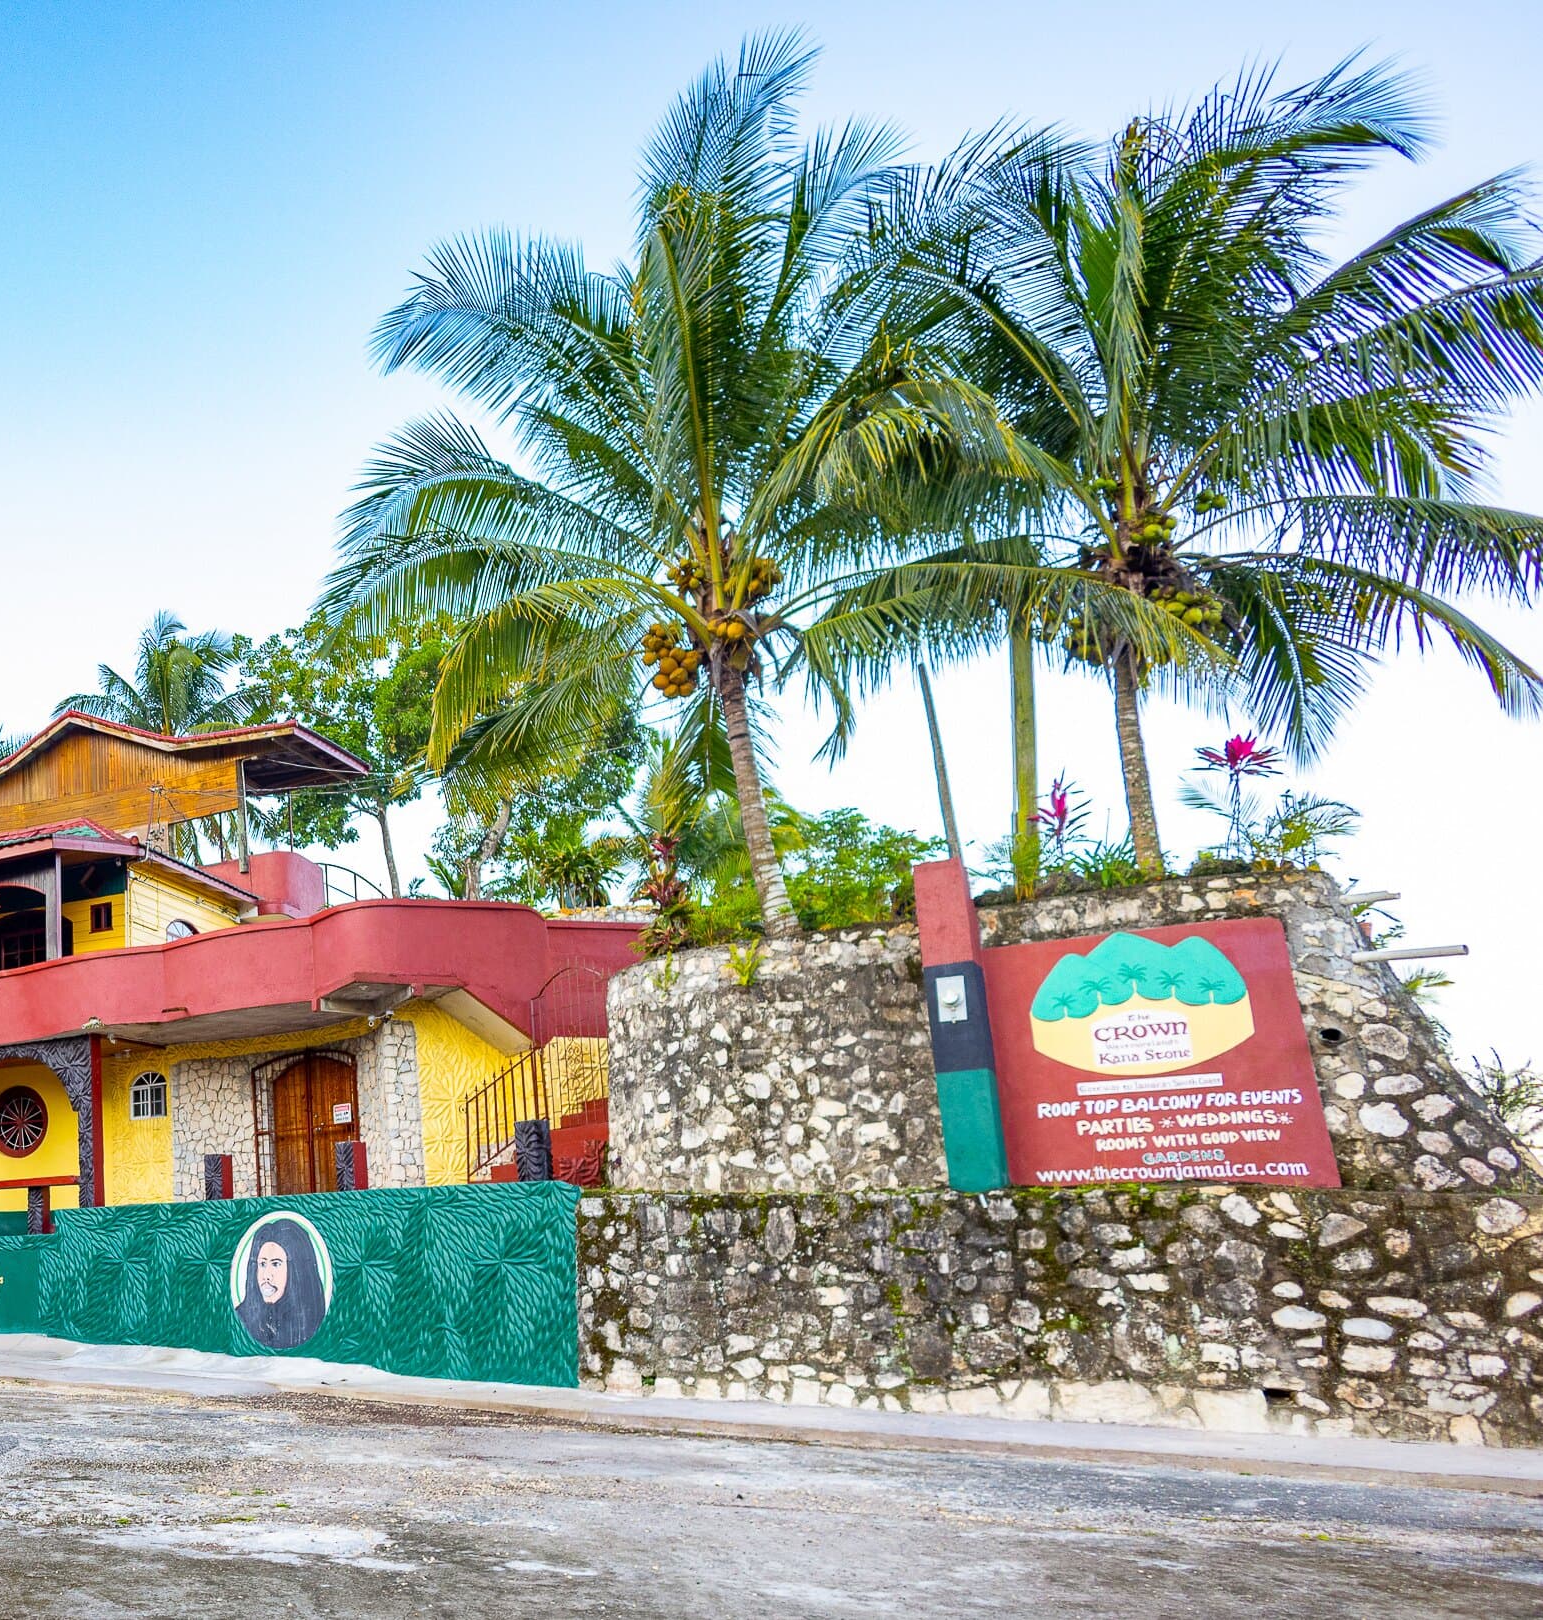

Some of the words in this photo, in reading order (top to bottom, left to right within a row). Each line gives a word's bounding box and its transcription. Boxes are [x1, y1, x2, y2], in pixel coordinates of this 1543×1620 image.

[1145, 1049, 1190, 1061] Stone
[1037, 1101, 1081, 1119] ROOF
[1083, 1098, 1119, 1115] TOP
[1121, 1093, 1203, 1114] BALCONY
[1205, 1091, 1238, 1107] FOR
[1240, 1088, 1303, 1106] EVENTS
[1076, 1117, 1155, 1136] PARTIES
[1176, 1109, 1278, 1128] WEDDINGS
[1095, 1136, 1147, 1152] ROOMS
[1151, 1133, 1198, 1148] WITH
[1200, 1131, 1239, 1145] GOOD
[1240, 1128, 1281, 1142] VIEW
[1141, 1148, 1225, 1165] GARDENS
[1036, 1161, 1310, 1182] www.thecrownjamaica.com
